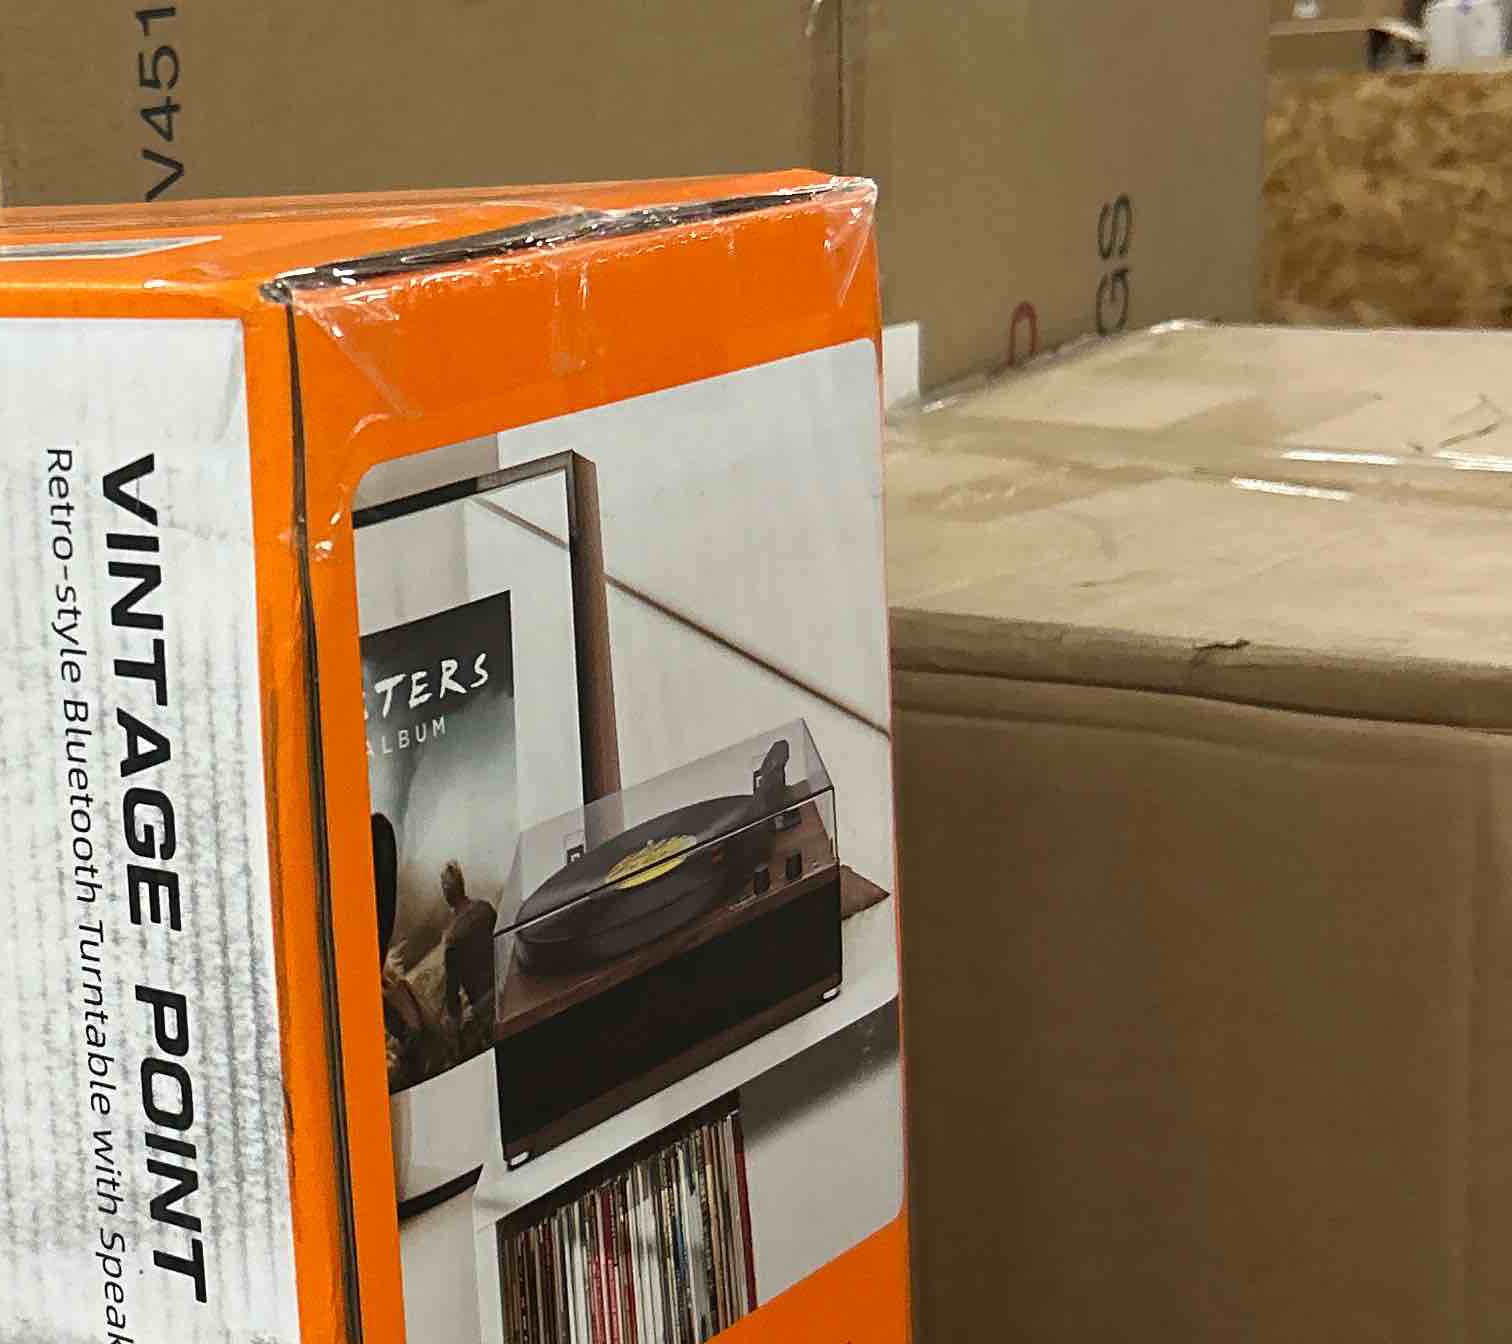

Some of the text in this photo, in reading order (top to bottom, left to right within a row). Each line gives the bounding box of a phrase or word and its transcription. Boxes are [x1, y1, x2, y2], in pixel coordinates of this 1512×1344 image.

[46, 448, 88, 684] Retro-style
[102, 453, 182, 932] VINTAGE
[362, 653, 489, 720] TERS
[63, 700, 104, 904] Bluetooth
[78, 920, 117, 1116] Turntable
[93, 1130, 118, 1215] with
[135, 983, 207, 1304] POINT
